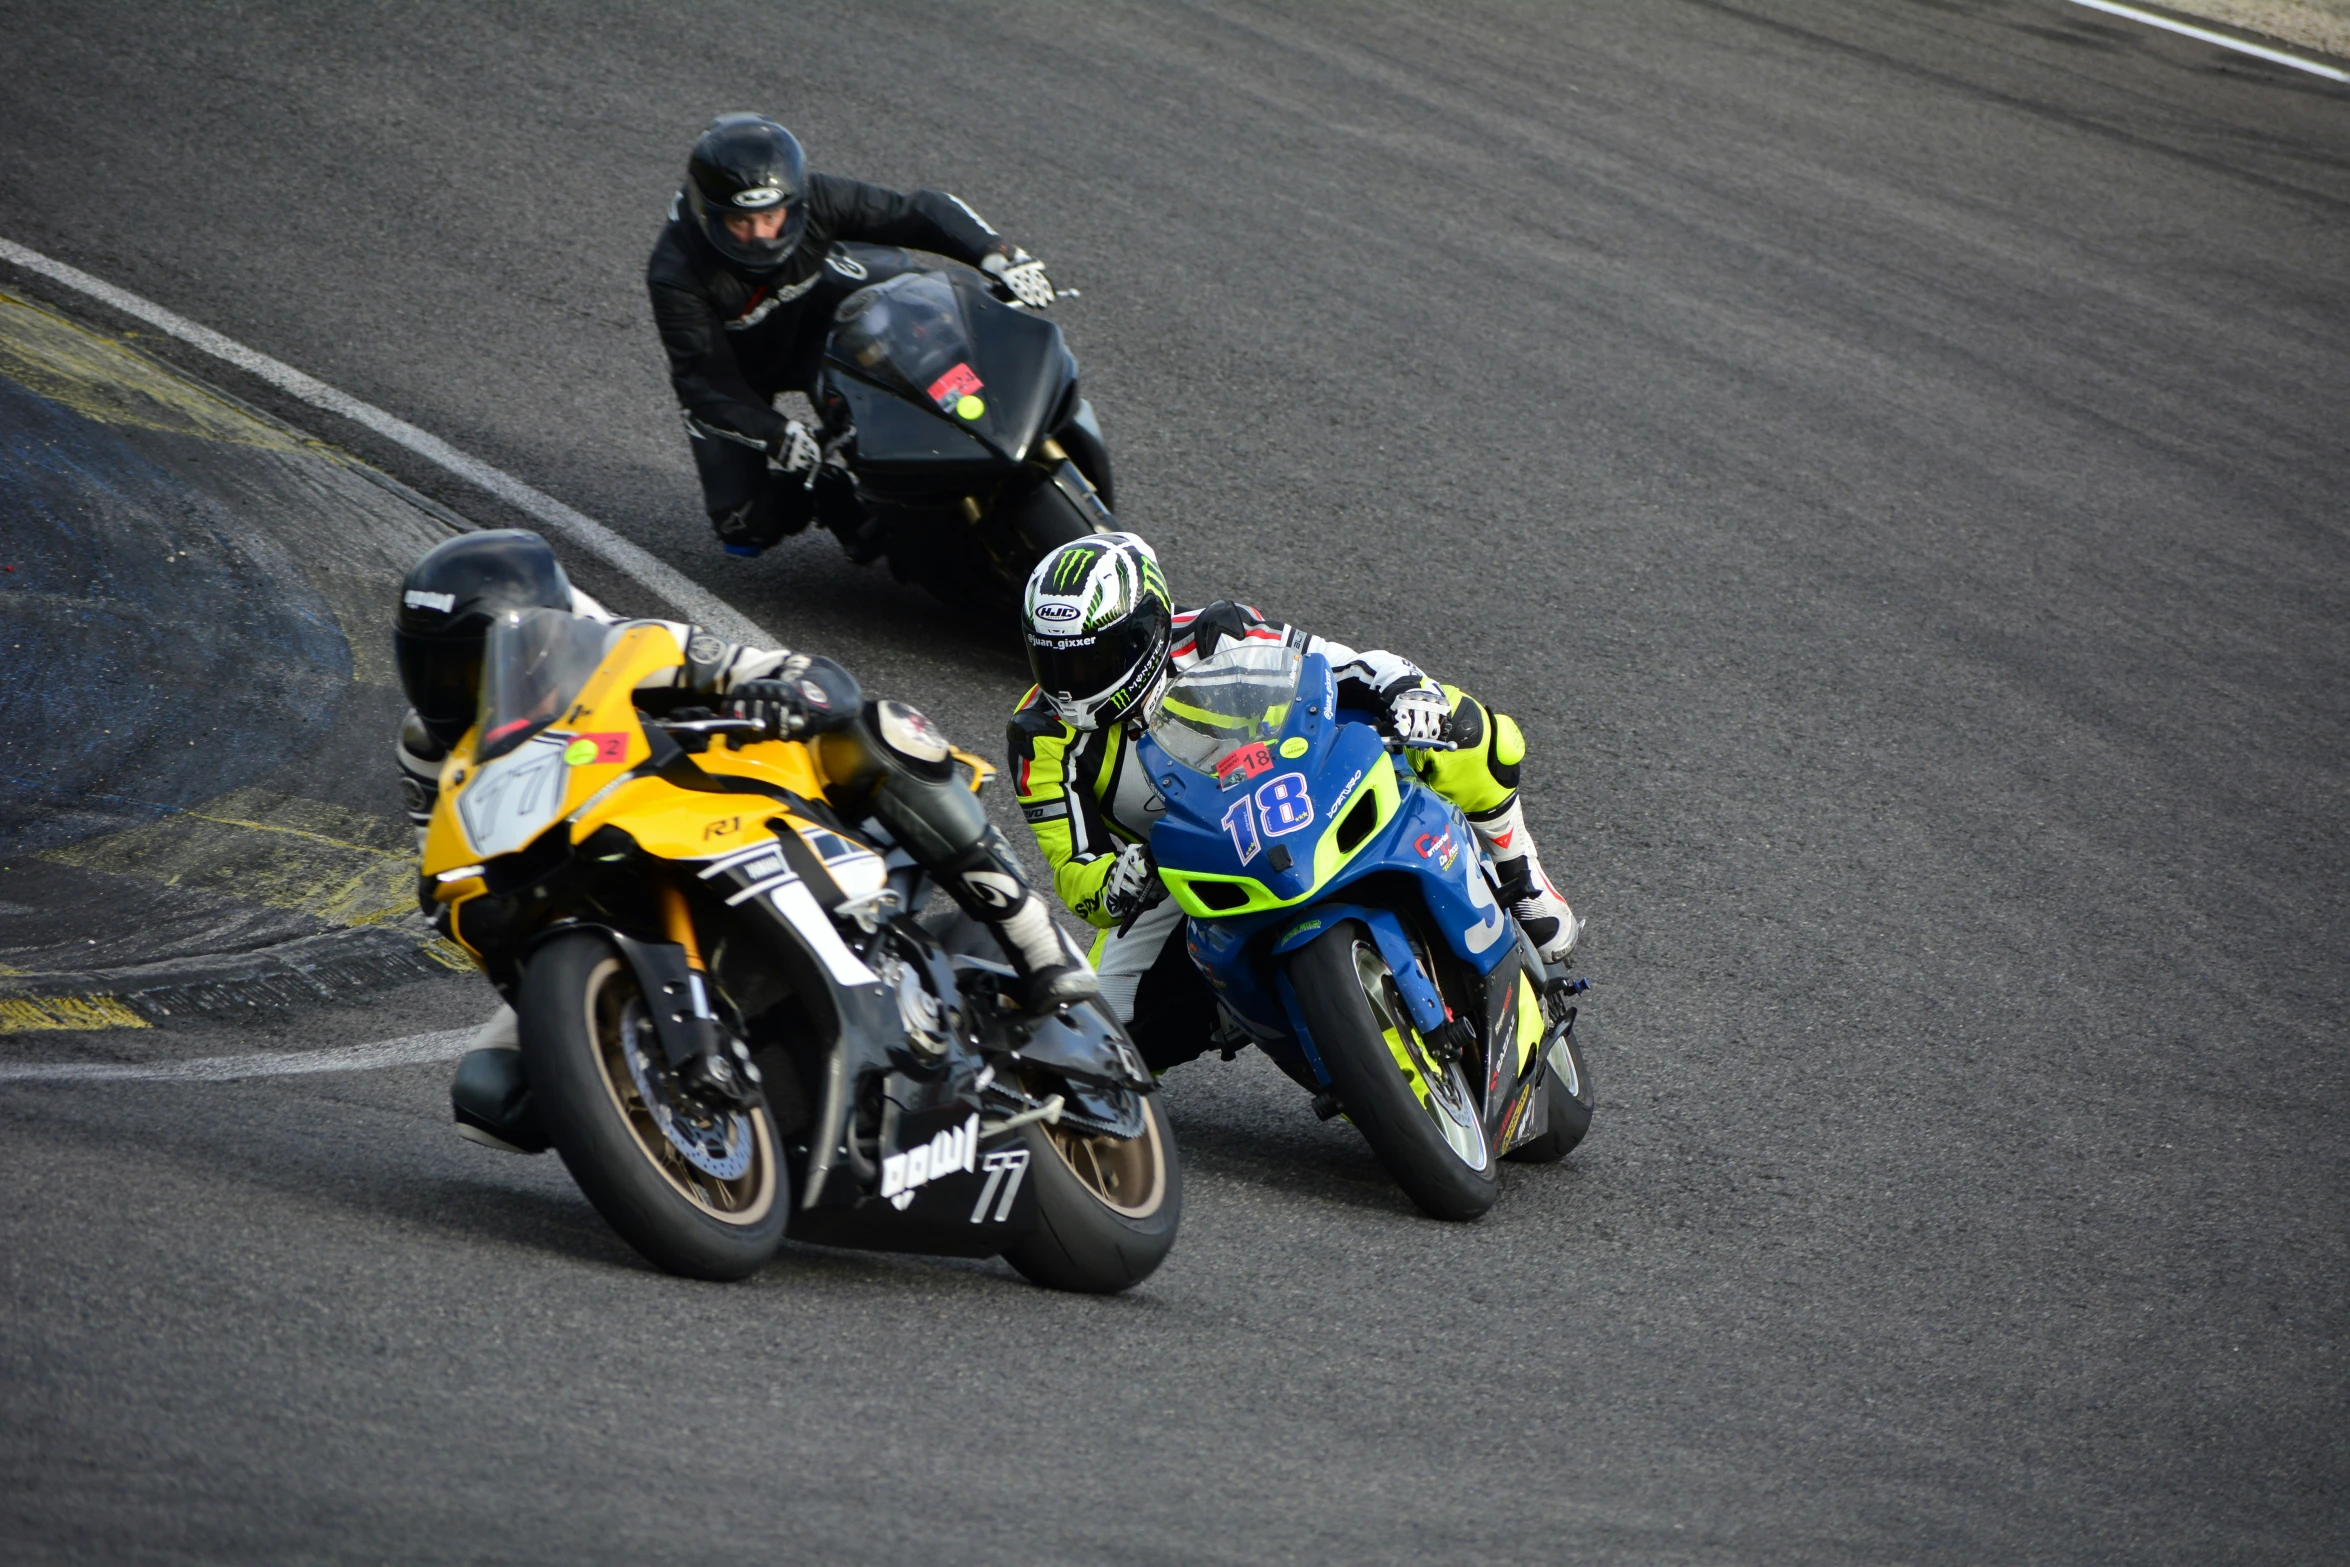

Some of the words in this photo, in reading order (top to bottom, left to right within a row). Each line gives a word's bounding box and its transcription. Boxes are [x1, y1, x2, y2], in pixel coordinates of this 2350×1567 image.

[1040, 608, 1074, 617] HJC
[1027, 634, 1096, 649] @juan_gixxer
[1323, 668, 1334, 720] @juan_gixxer
[1243, 750, 1270, 770] 18
[475, 750, 562, 841] 77
[704, 816, 741, 842] R1
[1221, 772, 1314, 867] 18
[970, 1149, 1030, 1223] 77
